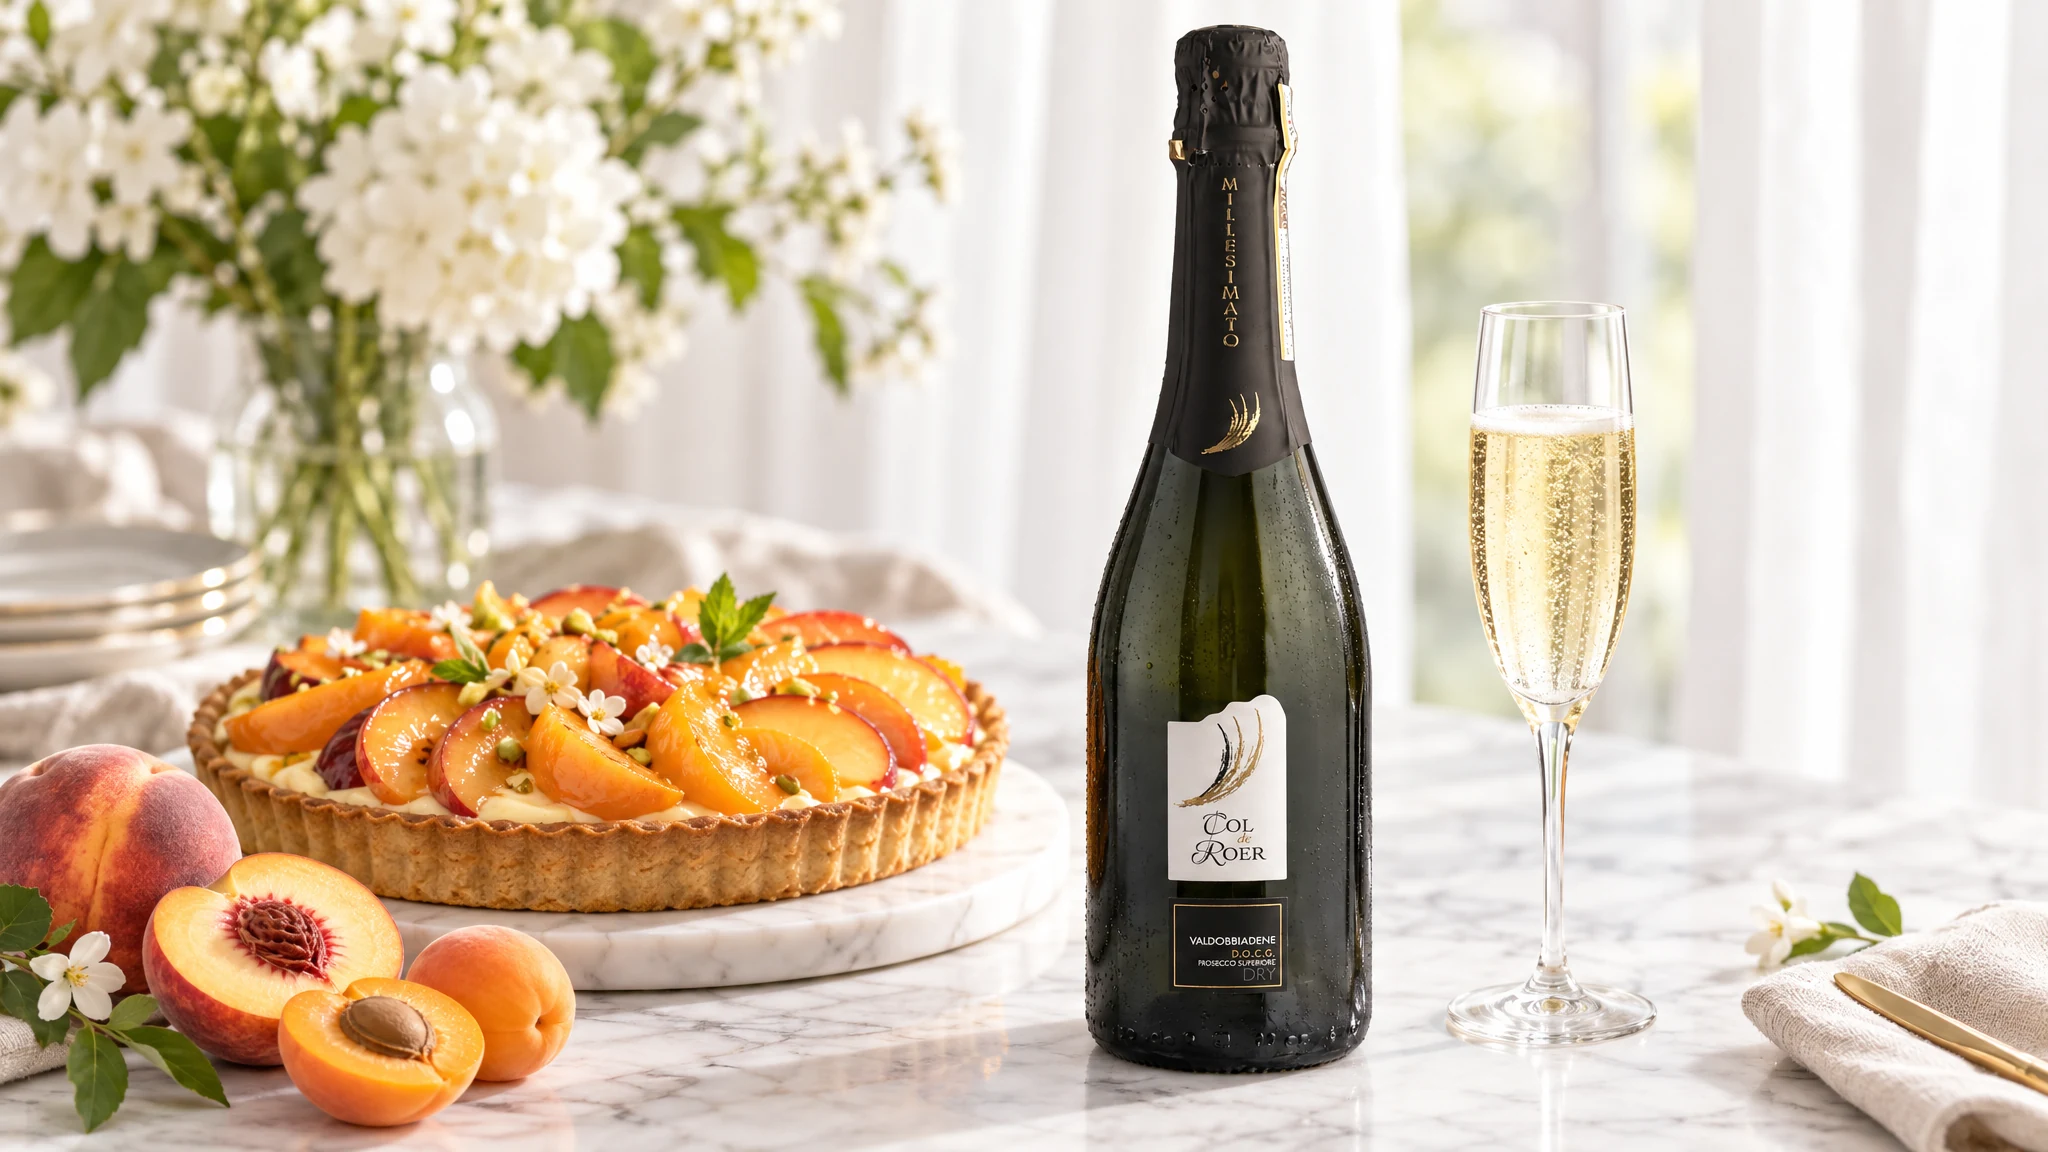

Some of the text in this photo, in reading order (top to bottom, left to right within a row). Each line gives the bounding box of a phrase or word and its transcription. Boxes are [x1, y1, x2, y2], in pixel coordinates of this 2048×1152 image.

[1221, 177, 1240, 348] MILLESIMATO
[1237, 833, 1251, 843] de
[1189, 935, 1276, 946] VALDOBBIADENE
[1231, 948, 1276, 958] D.O.C.G.
[1238, 959, 1276, 967] SUPERIORE
[1243, 967, 1276, 981] DRY
